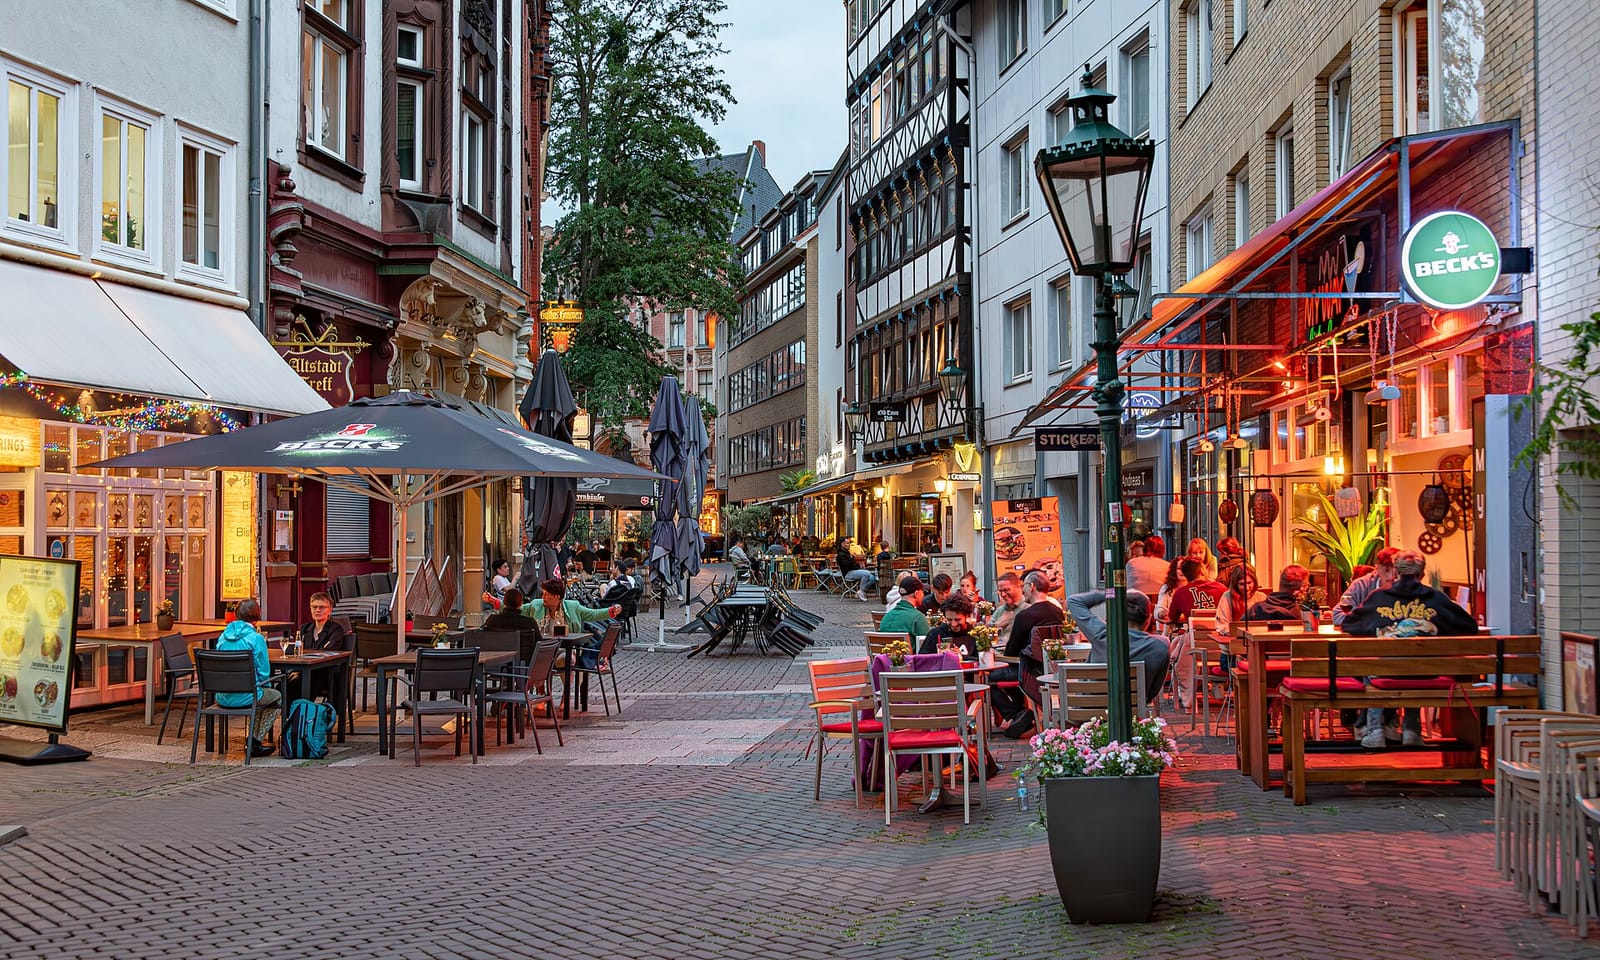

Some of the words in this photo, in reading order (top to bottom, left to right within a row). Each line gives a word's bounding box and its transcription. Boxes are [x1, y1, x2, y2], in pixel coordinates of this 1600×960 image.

[1414, 252, 1496, 278] BECK'S
[288, 357, 343, 374] Altstadt
[266, 439, 403, 453] BECK'S
[1189, 586, 1216, 610] LA
